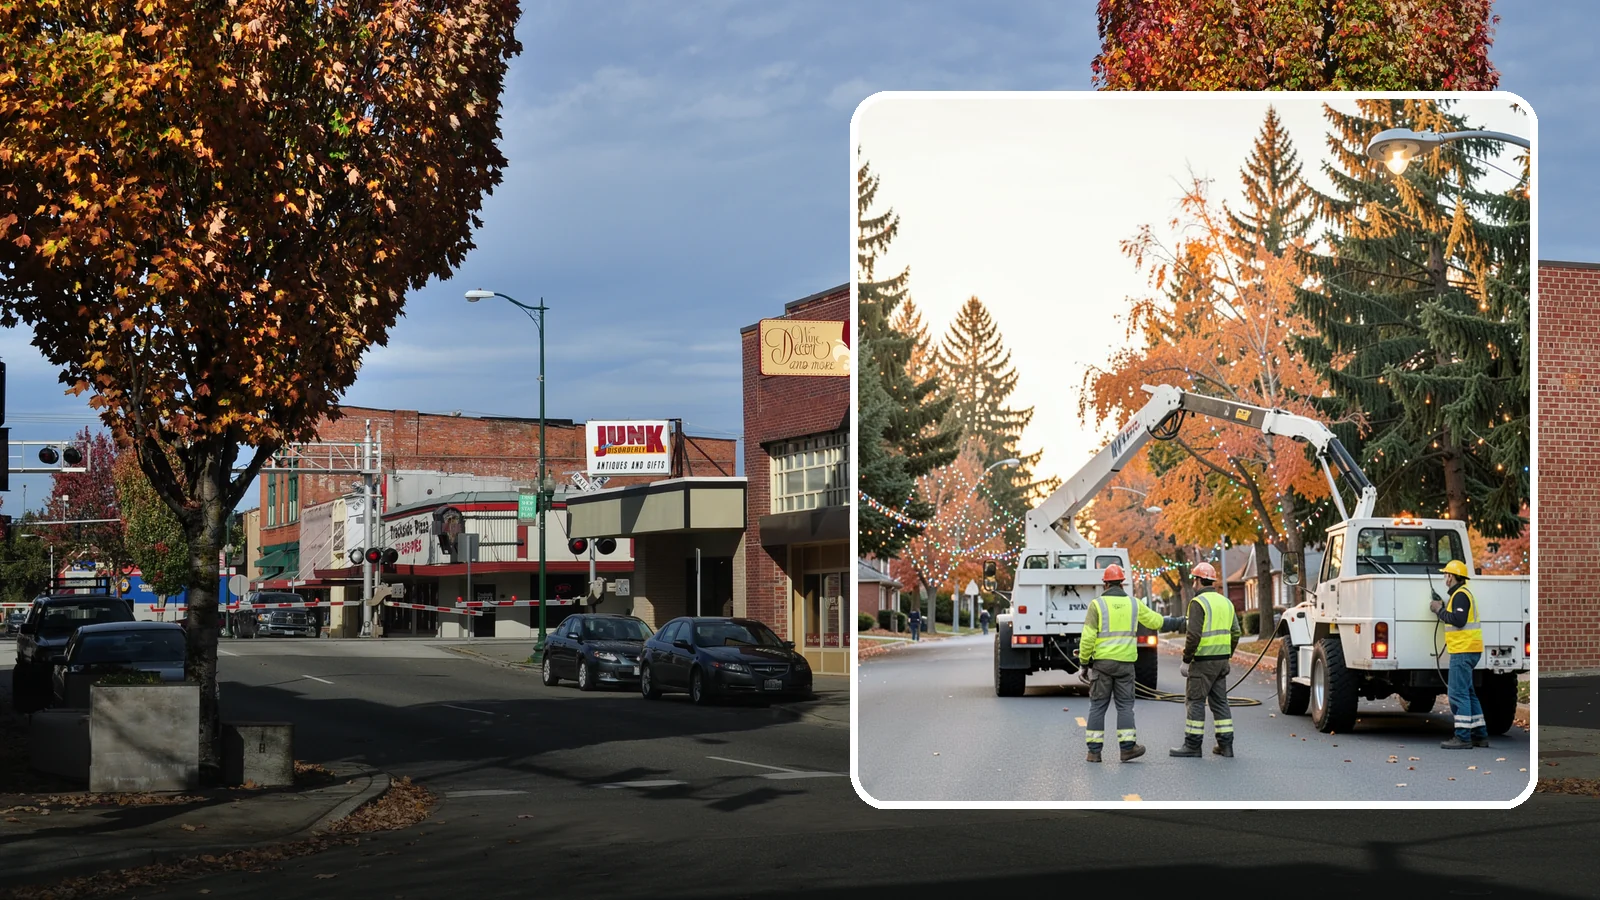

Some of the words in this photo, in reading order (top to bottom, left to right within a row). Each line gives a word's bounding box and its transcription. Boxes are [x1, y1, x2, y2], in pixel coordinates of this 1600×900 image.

[595, 425, 665, 457] JUNK
[607, 446, 645, 454] DISORDERLY
[597, 461, 628, 470] ANTIQUES
[631, 461, 644, 470] AND
[647, 461, 665, 470] GIFTS
[415, 519, 429, 534] Pizza
